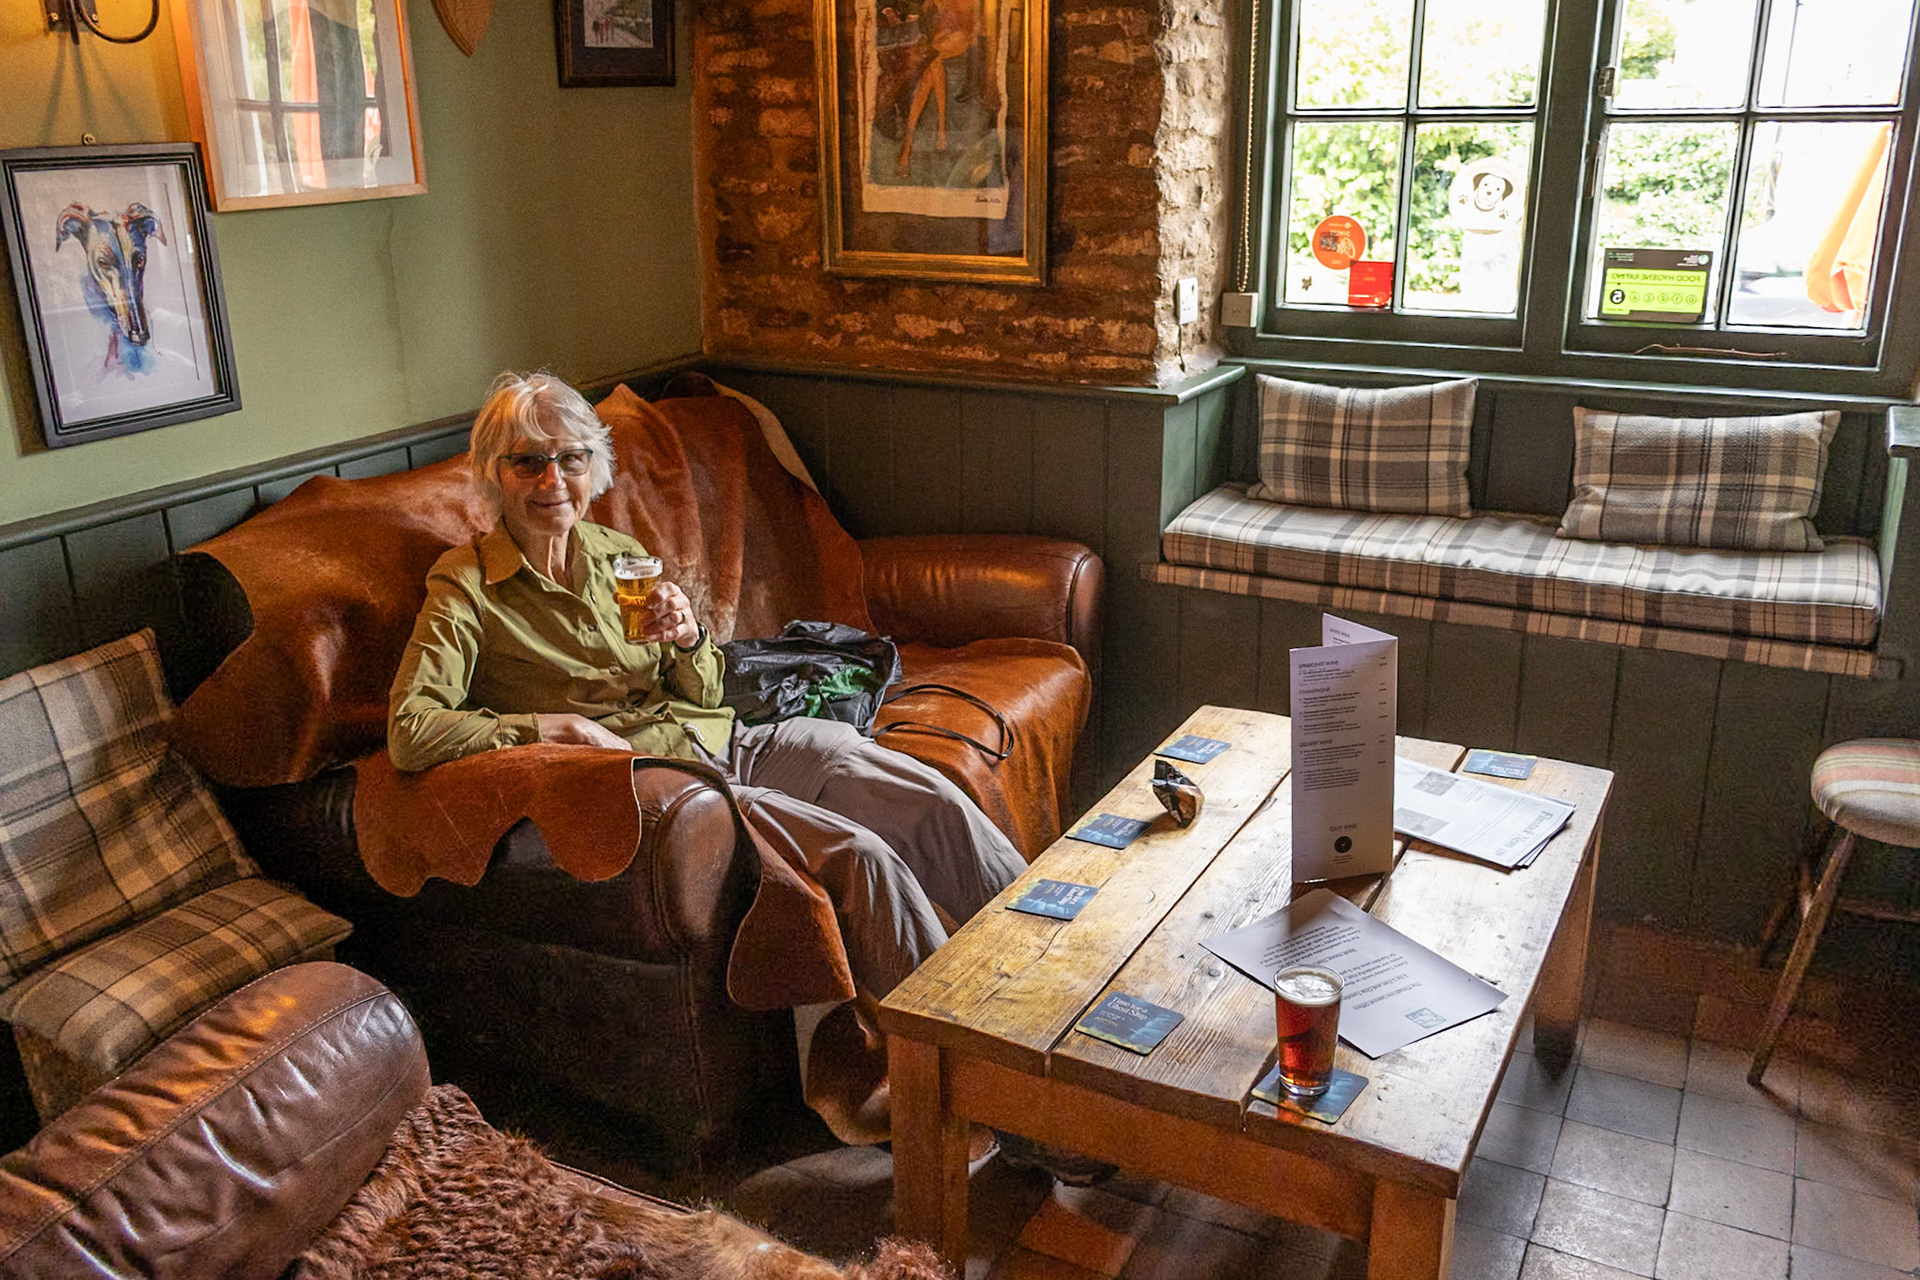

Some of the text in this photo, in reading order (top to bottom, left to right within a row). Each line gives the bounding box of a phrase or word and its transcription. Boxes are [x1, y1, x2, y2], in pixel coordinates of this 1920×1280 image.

[1357, 965, 1381, 976] wonderful
[1111, 996, 1131, 1007] Time
[1107, 1002, 1130, 1015] Ghost
[1128, 1009, 1148, 1020] Ship
